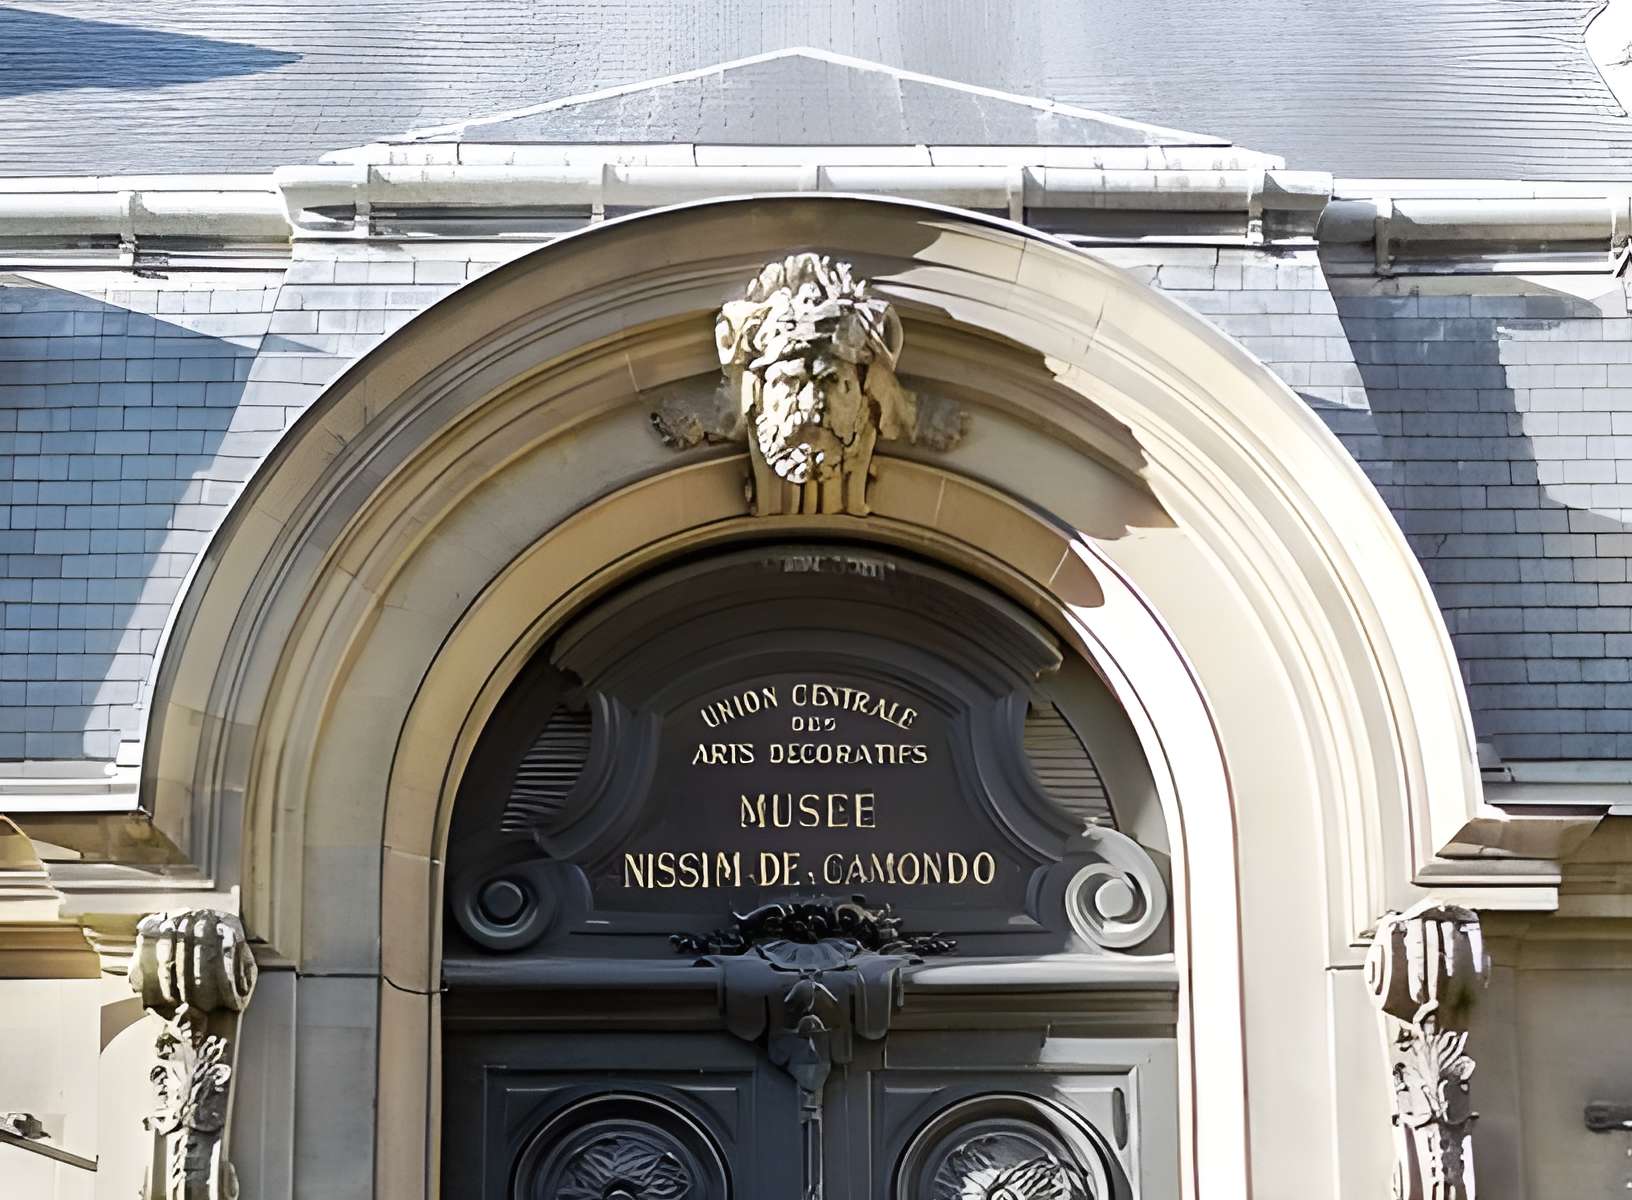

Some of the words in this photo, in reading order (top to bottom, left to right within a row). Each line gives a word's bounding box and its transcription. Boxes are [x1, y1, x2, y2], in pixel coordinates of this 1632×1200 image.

[700, 686, 779, 728] UNION
[791, 684, 918, 730] CENTRALE
[691, 743, 755, 765] ARTS
[769, 743, 928, 764] DECORATIFS
[740, 793, 876, 828] MUSEE
[623, 851, 741, 889] NISSIM
[760, 851, 801, 887] DE
[823, 851, 996, 888] CAMONDO
